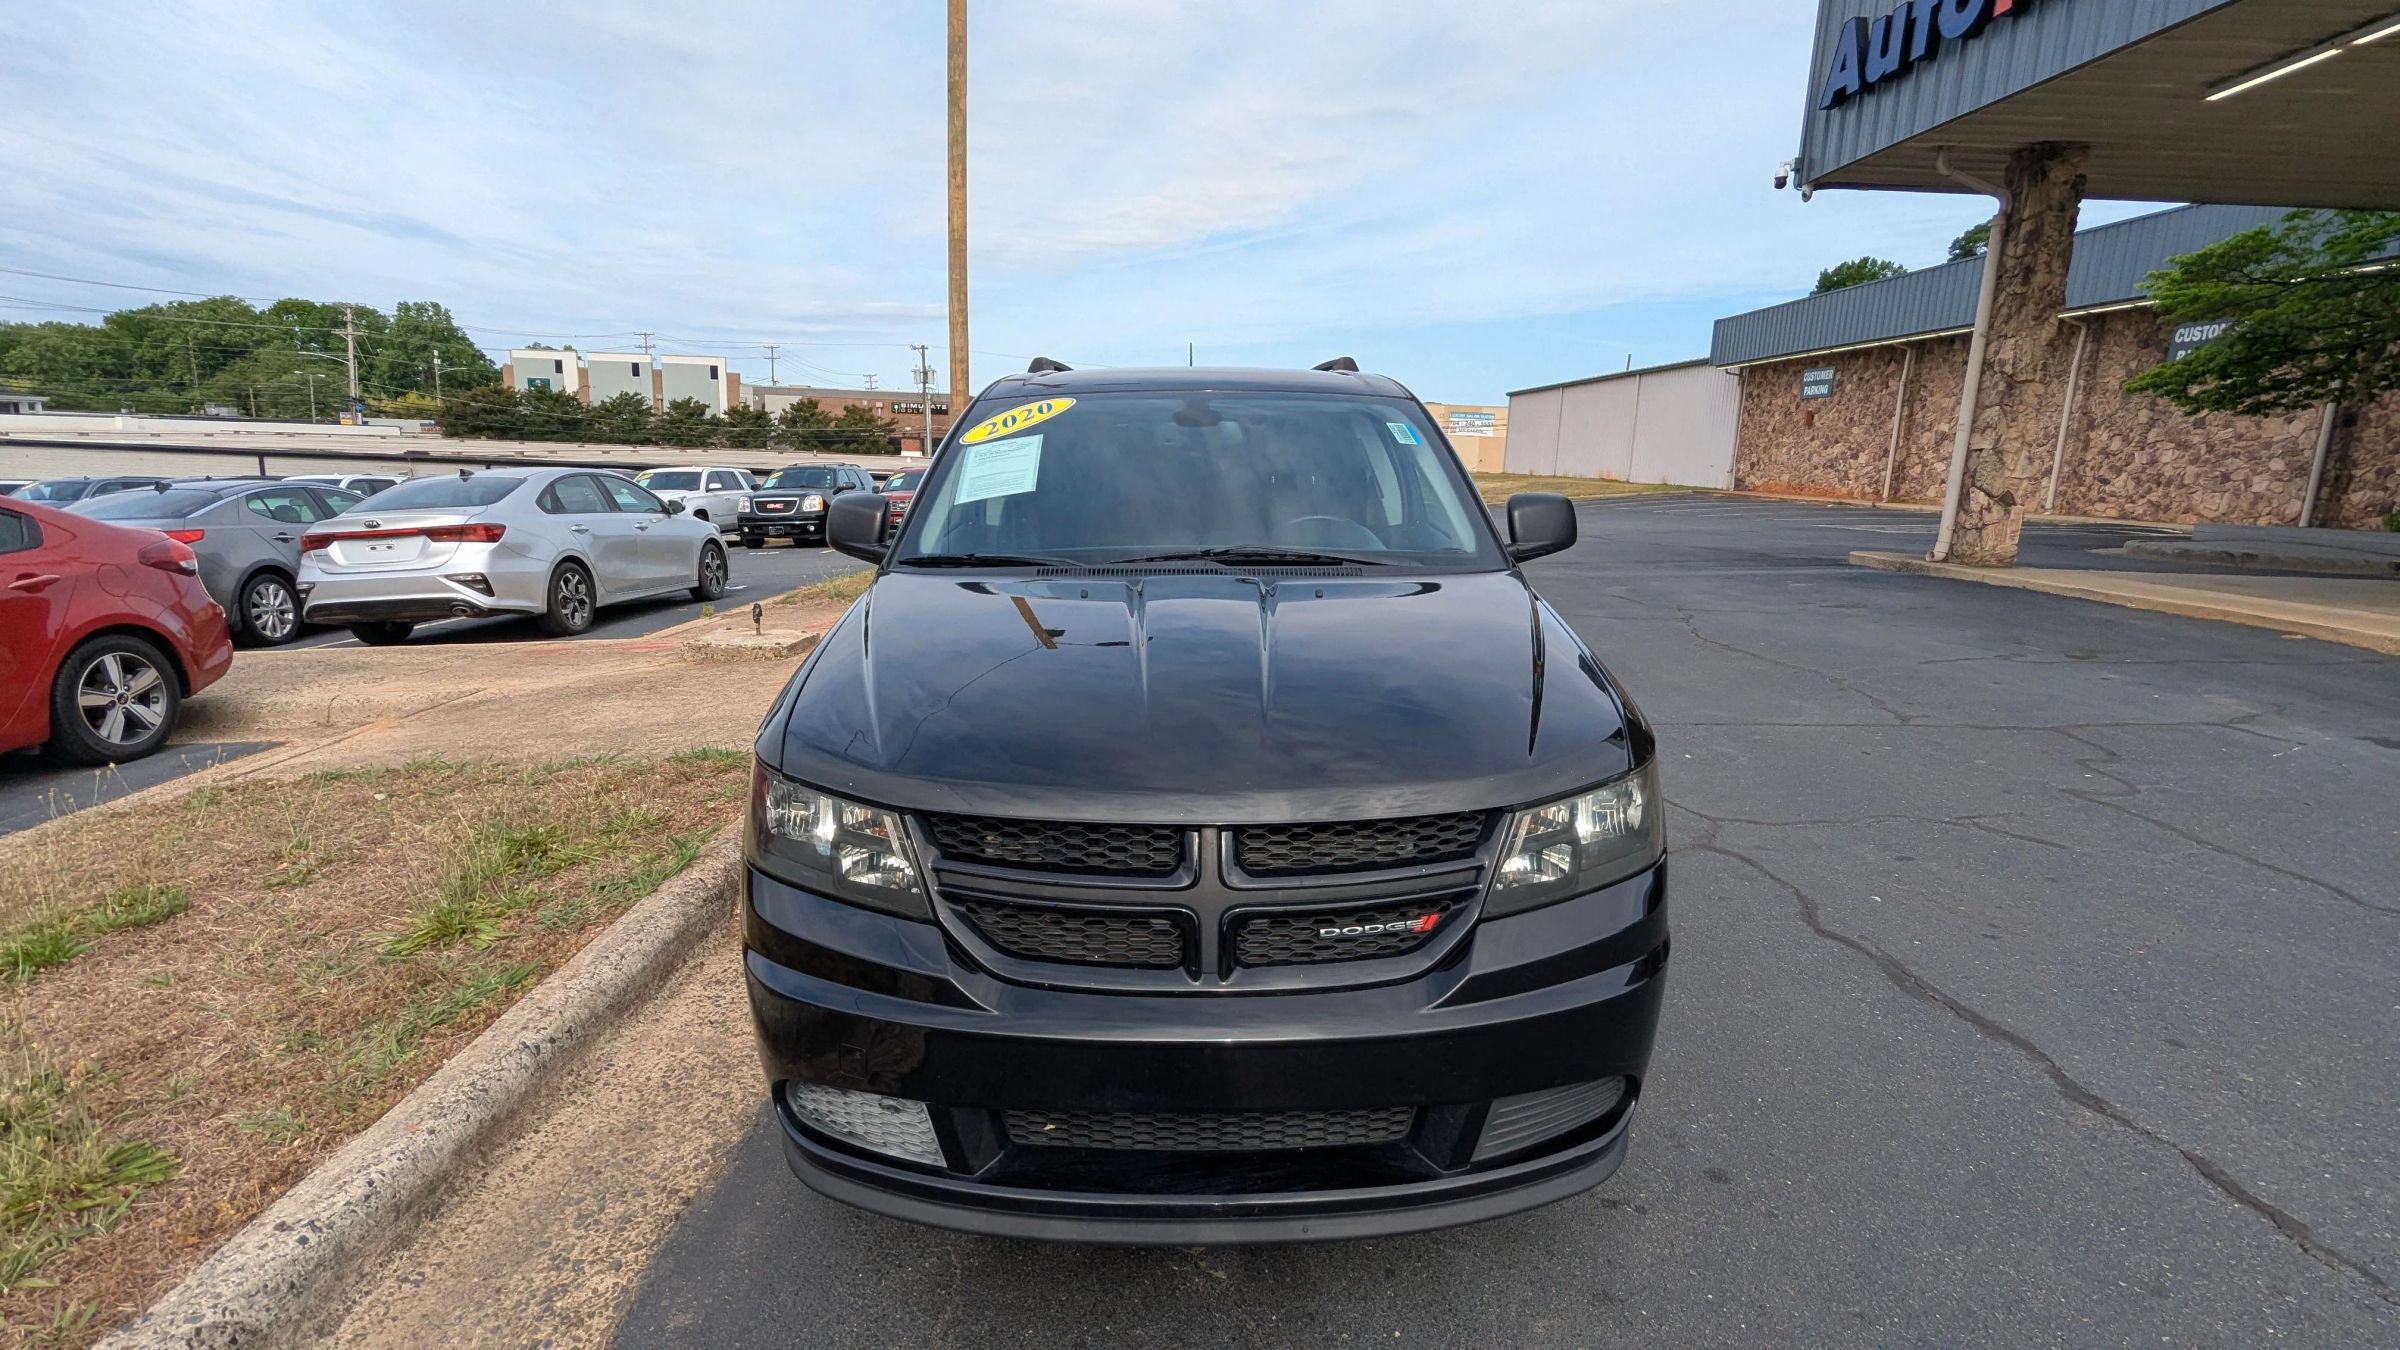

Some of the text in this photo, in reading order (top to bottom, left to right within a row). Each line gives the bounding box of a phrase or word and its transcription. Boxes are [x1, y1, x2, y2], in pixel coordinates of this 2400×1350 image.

[1803, 369, 1834, 382] CUSTOMER
[1803, 384, 1829, 396] PARKING
[900, 402, 948, 410] SIMUATE
[984, 402, 1053, 437] 2020
[1320, 919, 1424, 937] DODGE
